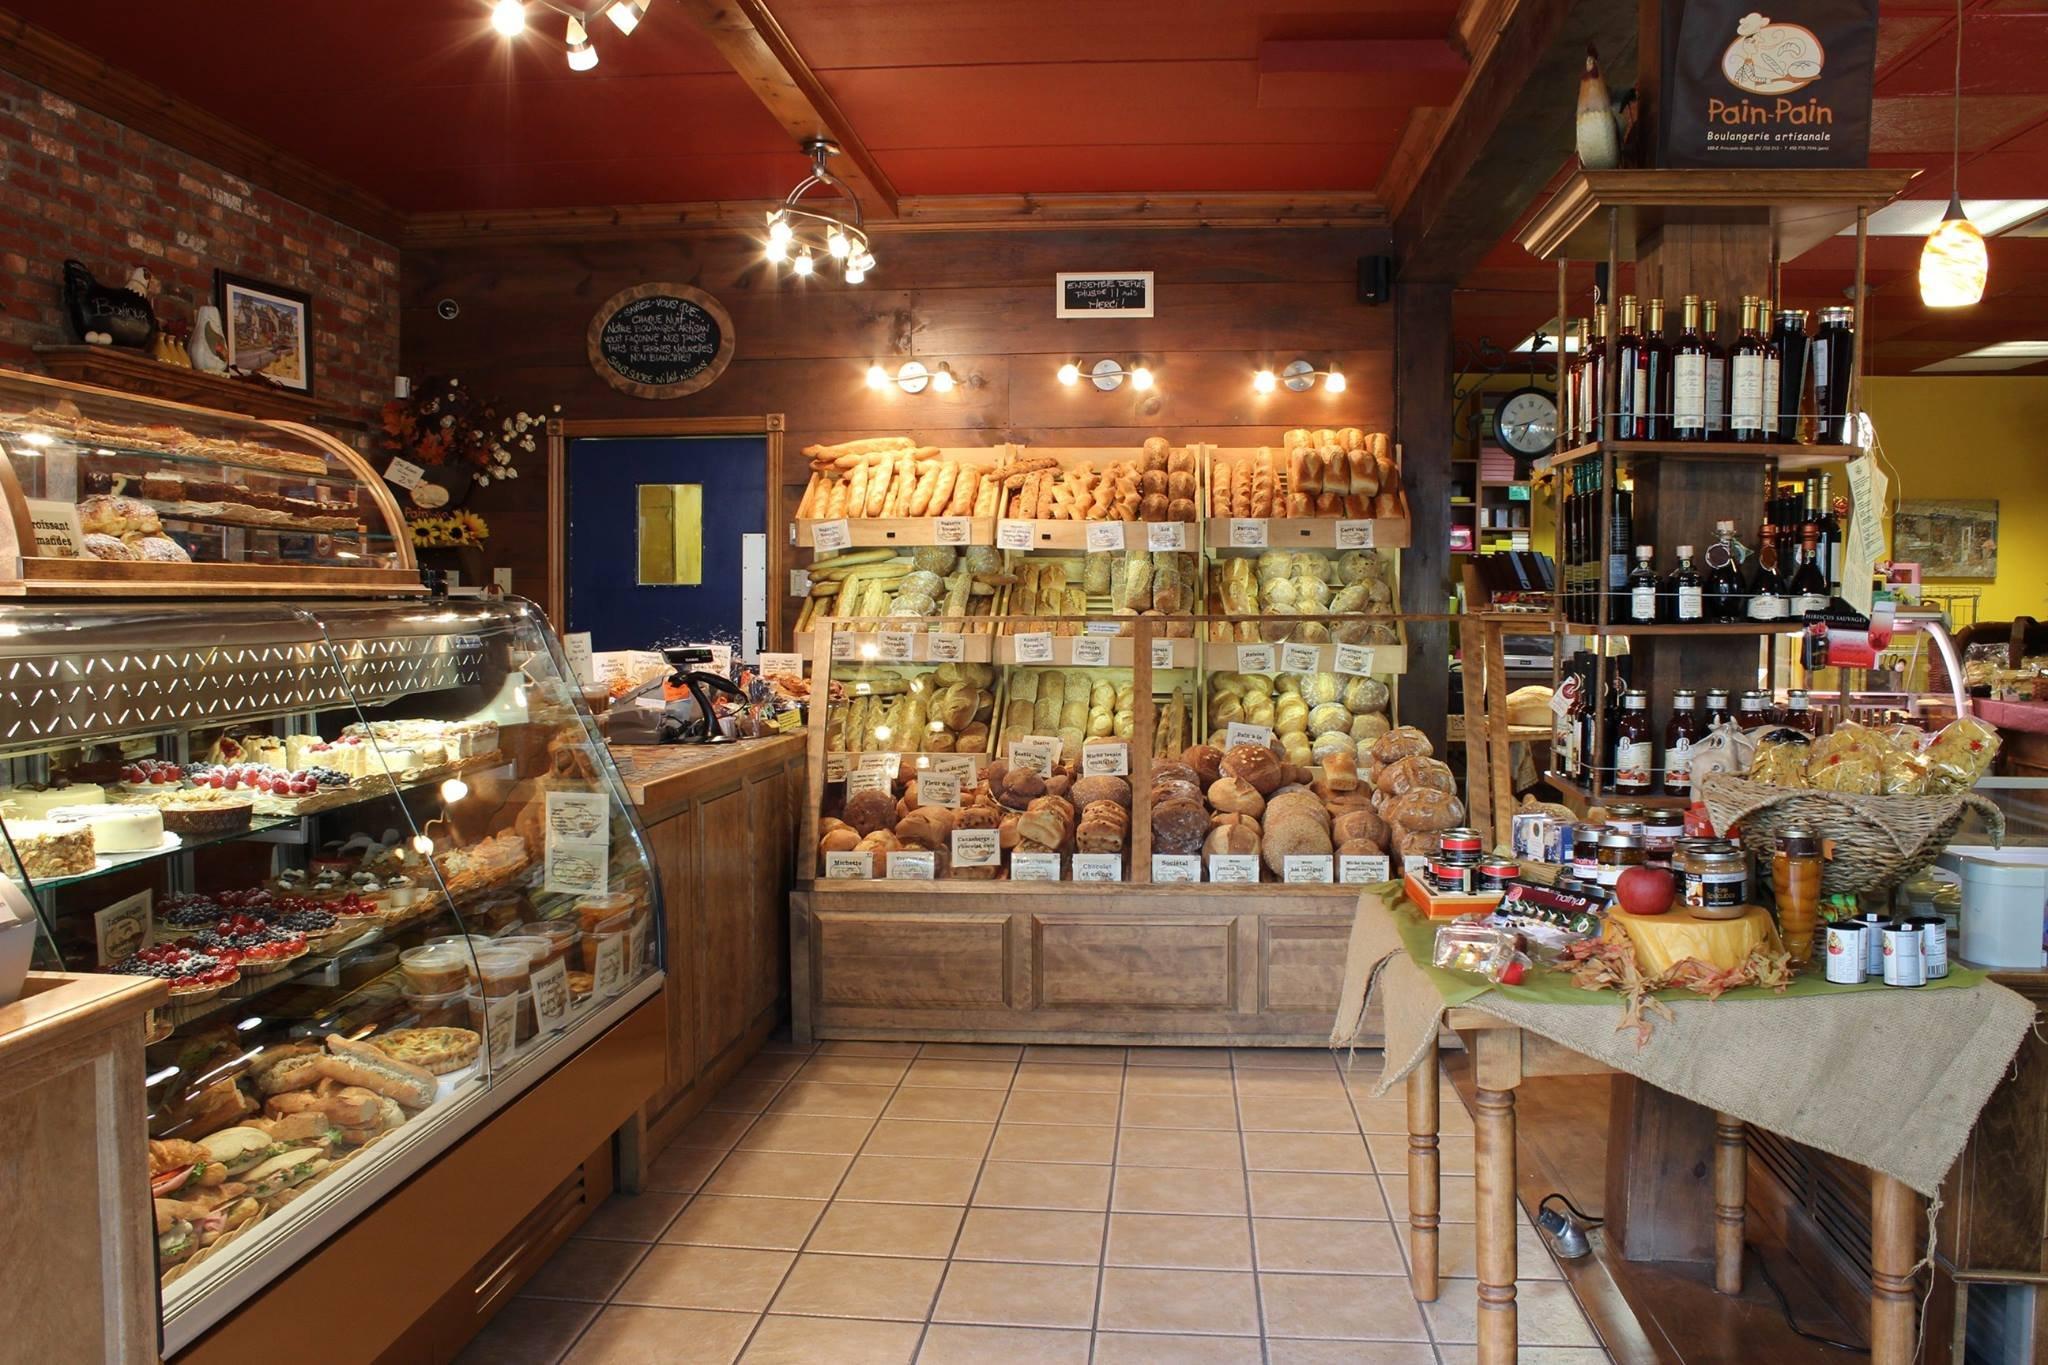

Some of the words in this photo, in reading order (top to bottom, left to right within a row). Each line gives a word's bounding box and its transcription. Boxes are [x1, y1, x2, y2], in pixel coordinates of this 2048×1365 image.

[1708, 98, 1832, 125] Pain-Pain
[1707, 131, 1770, 143] Boulangerie
[1775, 131, 1831, 141] artisanale
[32, 520, 70, 530] roissant
[35, 536, 72, 546] mandes
[1836, 615, 1866, 623] SAUVAGES
